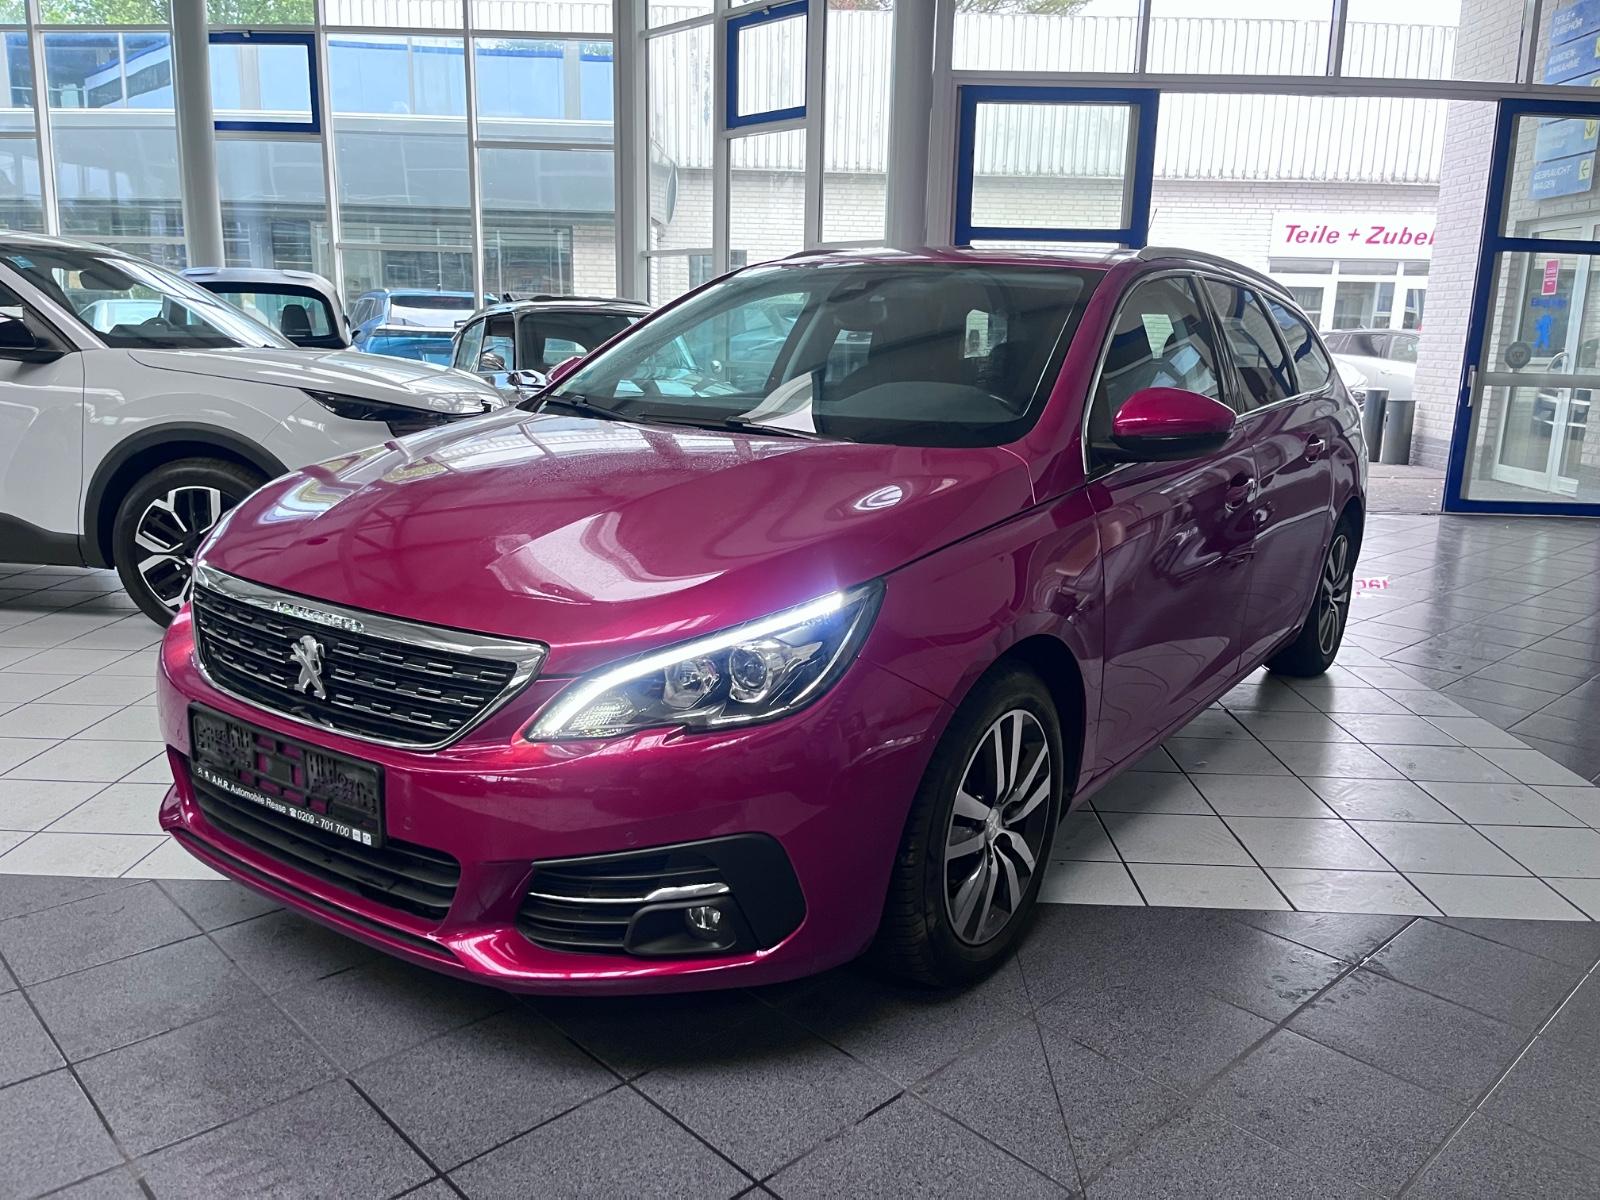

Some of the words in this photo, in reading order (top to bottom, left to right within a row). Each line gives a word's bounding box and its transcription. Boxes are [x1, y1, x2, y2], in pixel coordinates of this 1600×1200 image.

[1285, 225, 1340, 244] Teile
[1348, 228, 1360, 240] +
[230, 784, 265, 805] Automobile
[265, 797, 287, 814] Resse
[297, 810, 315, 824] 0209
[321, 818, 334, 832] 701
[336, 824, 350, 837] 700
